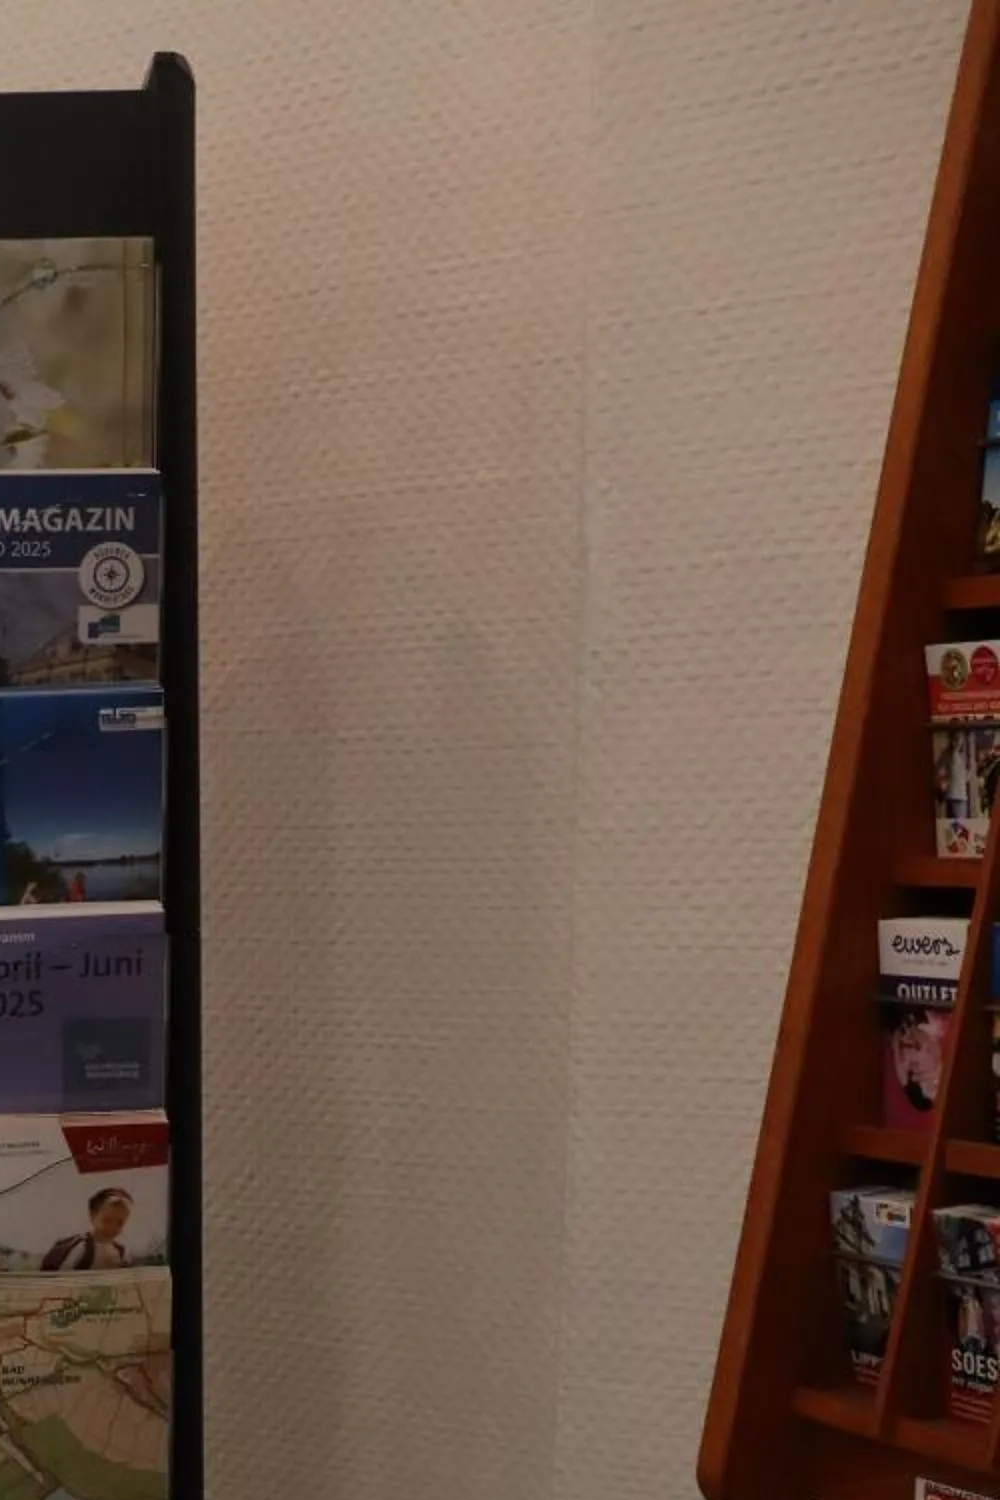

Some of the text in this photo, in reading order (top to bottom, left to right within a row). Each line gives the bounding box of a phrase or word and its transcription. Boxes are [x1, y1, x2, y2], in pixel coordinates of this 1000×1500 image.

[11, 539, 52, 557] 2025
[891, 935, 961, 957] ewers
[78, 949, 144, 978] Juni
[951, 1347, 1000, 1383] SOES
